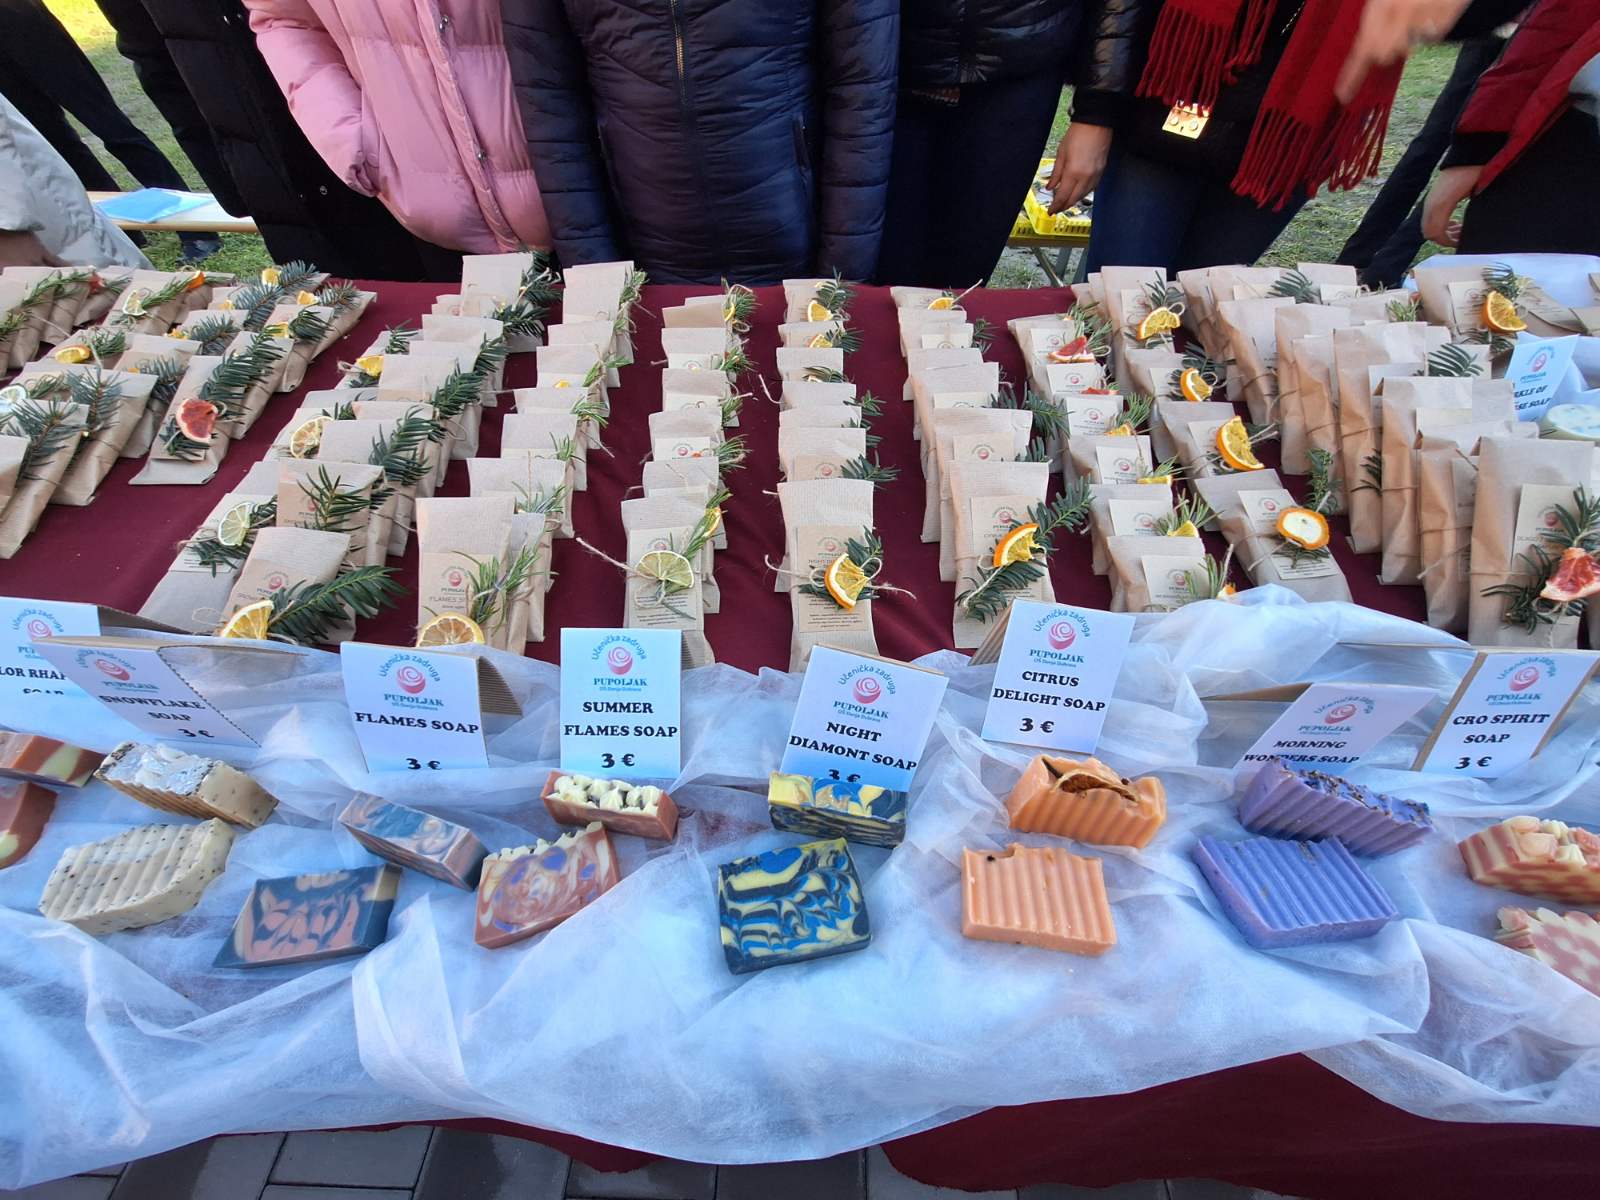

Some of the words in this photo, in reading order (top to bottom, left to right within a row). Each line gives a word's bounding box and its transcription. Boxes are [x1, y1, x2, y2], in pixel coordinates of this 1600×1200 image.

[1034, 608, 1068, 632] Učenička
[1068, 611, 1090, 638] zadruga
[622, 636, 646, 660] zadruga
[1030, 649, 1084, 664] PUPOLJAK
[380, 654, 410, 677] Učenička
[412, 654, 440, 682] zadruga
[594, 678, 648, 686] PUPOLJAK
[838, 664, 874, 685] Učenička
[875, 668, 896, 695] zadruga
[1022, 671, 1080, 686] CITRUS
[98, 695, 206, 710] SNOWFLAKE
[384, 693, 444, 706] PUPOLJAK
[993, 688, 1061, 706] DELIGHT
[1064, 698, 1106, 712] SOAP
[582, 702, 654, 714] SUMMER
[833, 700, 888, 719] PUPOLJAK
[148, 712, 192, 721] SOAP
[354, 712, 428, 728] FLAMES
[431, 720, 479, 734] SOAP
[1452, 716, 1488, 725] CRO
[1490, 714, 1550, 724] SPIRIT
[178, 728, 196, 738] 3
[564, 724, 630, 736] FLAMES
[634, 726, 678, 737] SOAP
[826, 722, 881, 742] NIGHT
[1020, 718, 1034, 732] 3
[1040, 720, 1054, 733] €
[1274, 740, 1346, 748] MORNING
[1464, 734, 1510, 744] SOAP
[601, 752, 615, 768] 3
[622, 754, 636, 766] €
[789, 736, 870, 760] DIAMONT
[872, 754, 916, 770] SOAP
[1318, 755, 1360, 764] SOAP
[406, 758, 421, 770] 3
[428, 760, 442, 770] €
[1454, 756, 1470, 770] 3
[1476, 756, 1492, 767] €
[828, 769, 840, 780] 3
